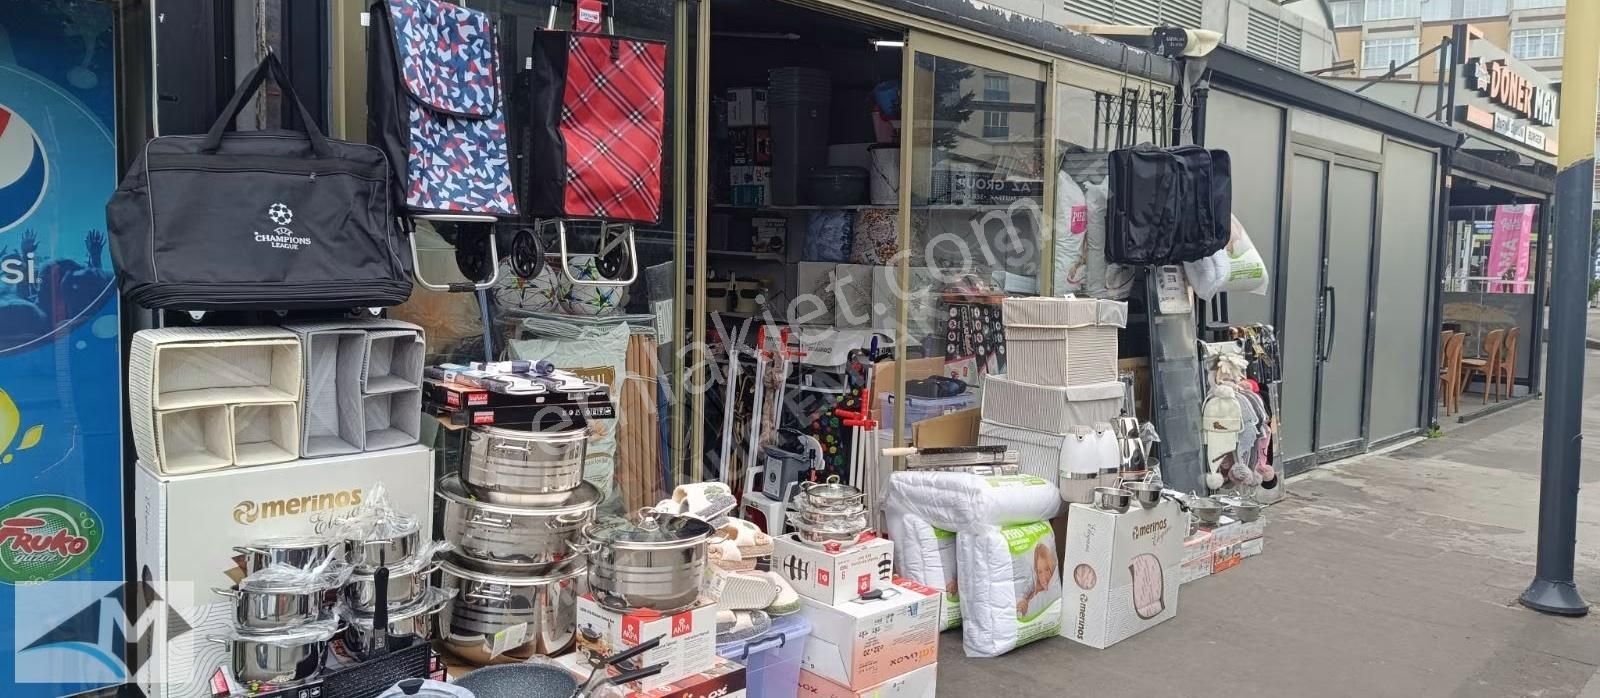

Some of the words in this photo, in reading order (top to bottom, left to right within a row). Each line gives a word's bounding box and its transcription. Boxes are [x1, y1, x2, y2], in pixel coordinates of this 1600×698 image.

[1534, 83, 1557, 127] MAX
[255, 234, 312, 245] CHAMPIONS
[271, 242, 299, 250] LEAGUE
[261, 488, 362, 519] merinos
[1139, 518, 1168, 537] merinos
[1076, 602, 1087, 641] merinos
[623, 630, 638, 641] AKPA
[673, 624, 690, 635] AKPA
